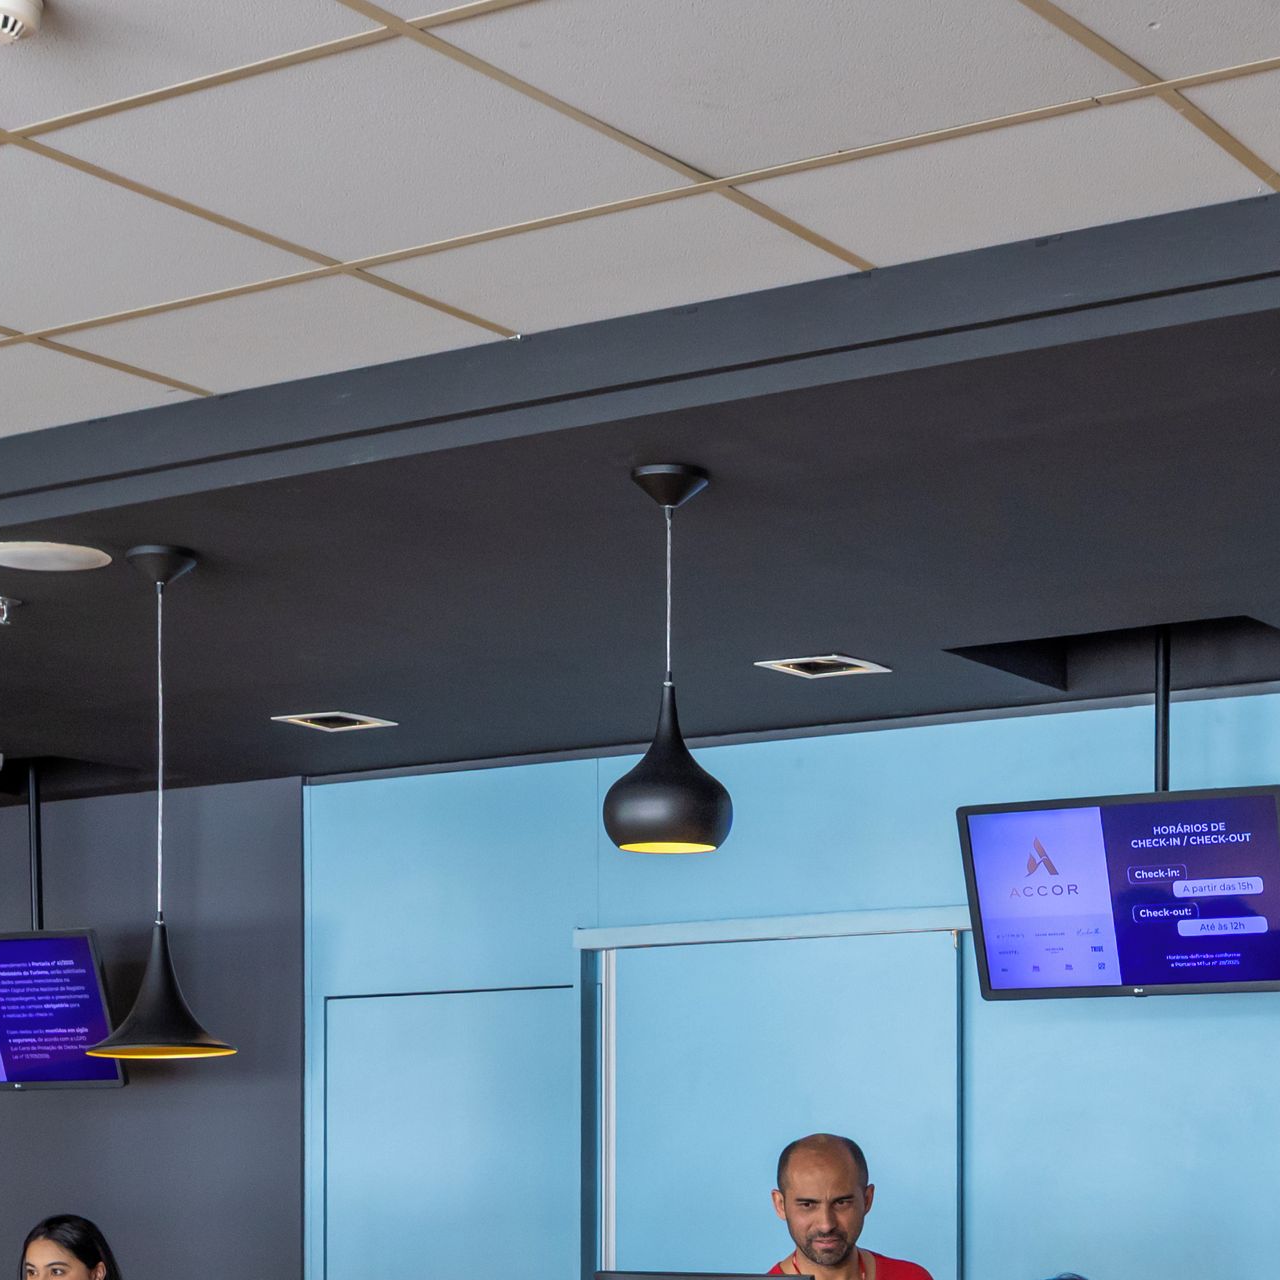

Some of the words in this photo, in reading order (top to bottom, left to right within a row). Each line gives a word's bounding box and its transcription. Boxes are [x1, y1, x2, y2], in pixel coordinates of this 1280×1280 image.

[1153, 823, 1208, 835] HORÁRIOS
[1211, 822, 1226, 831] DE
[1131, 837, 1180, 848] CHECK-IN
[1189, 833, 1251, 845] CHECK-OUT
[1135, 868, 1180, 879] Check-in:
[1010, 884, 1079, 898] ACCOR
[1183, 885, 1190, 893] A
[1192, 884, 1217, 894] partir
[1219, 882, 1236, 891] das
[1238, 882, 1253, 890] 15h
[1139, 908, 1192, 918] Check-out:
[1200, 923, 1216, 932] Até
[1218, 922, 1228, 931] às
[1230, 922, 1245, 930] 12h
